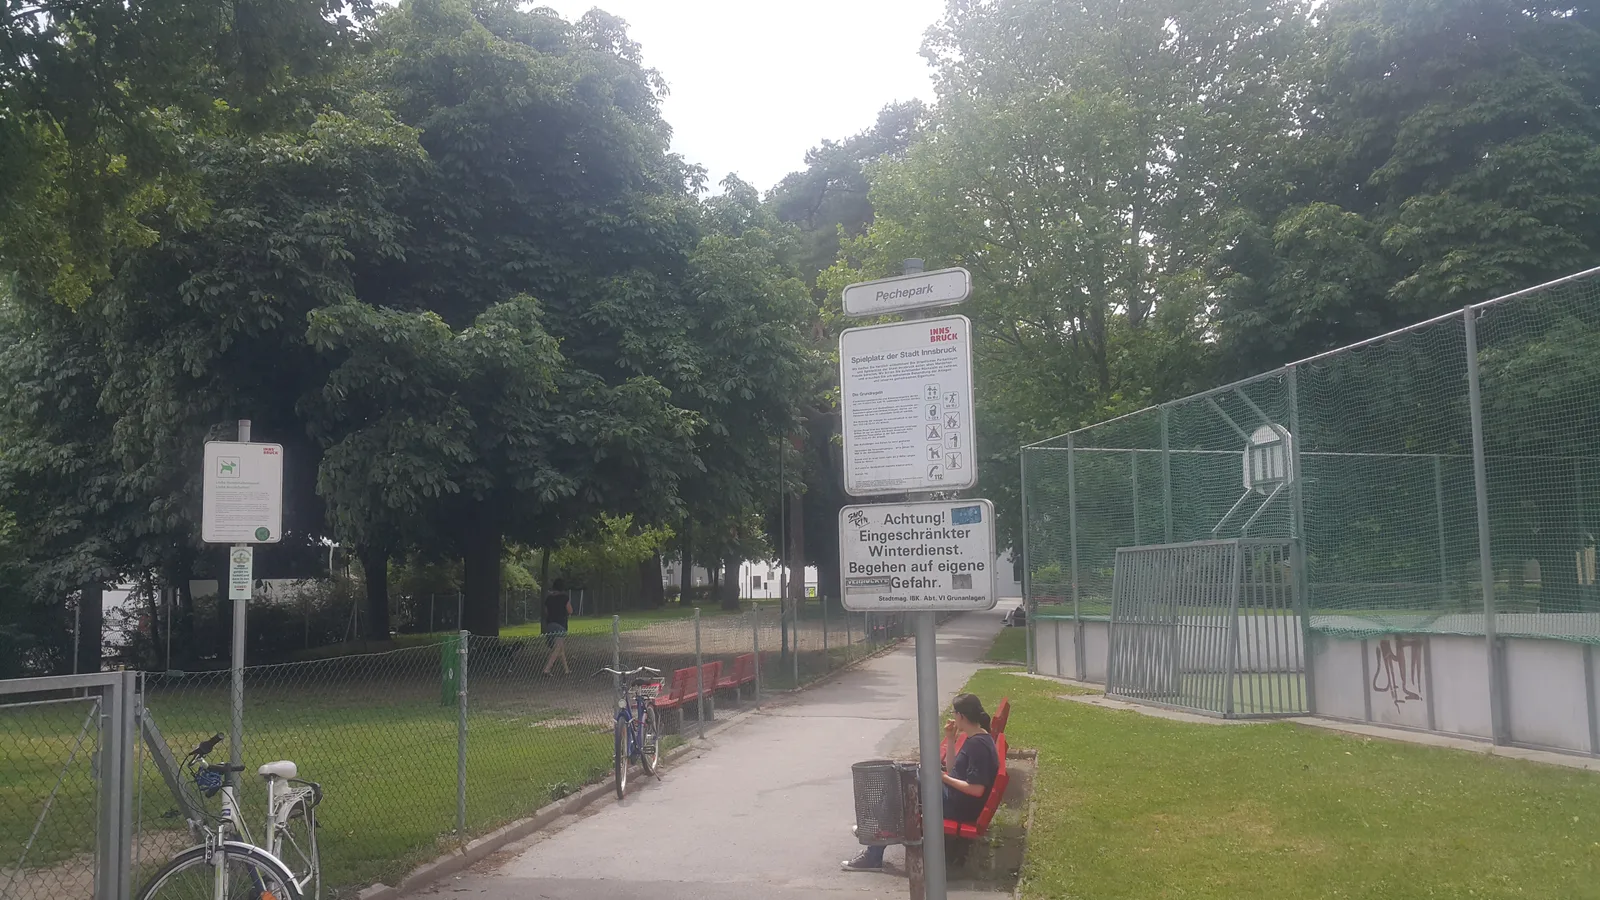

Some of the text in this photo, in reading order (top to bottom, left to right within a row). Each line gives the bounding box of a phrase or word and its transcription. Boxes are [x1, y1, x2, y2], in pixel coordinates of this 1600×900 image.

[875, 284, 934, 301] Pechepark
[930, 332, 958, 343] BRUCK
[851, 346, 957, 364] Spielplatz der Stadt Innsbruck
[883, 511, 945, 526] Achtung!
[859, 528, 971, 544] Eingeschränkter
[868, 544, 963, 557] Winterdienst.
[849, 559, 985, 575] Begehen auf eigene
[891, 576, 942, 589] Gefahr.
